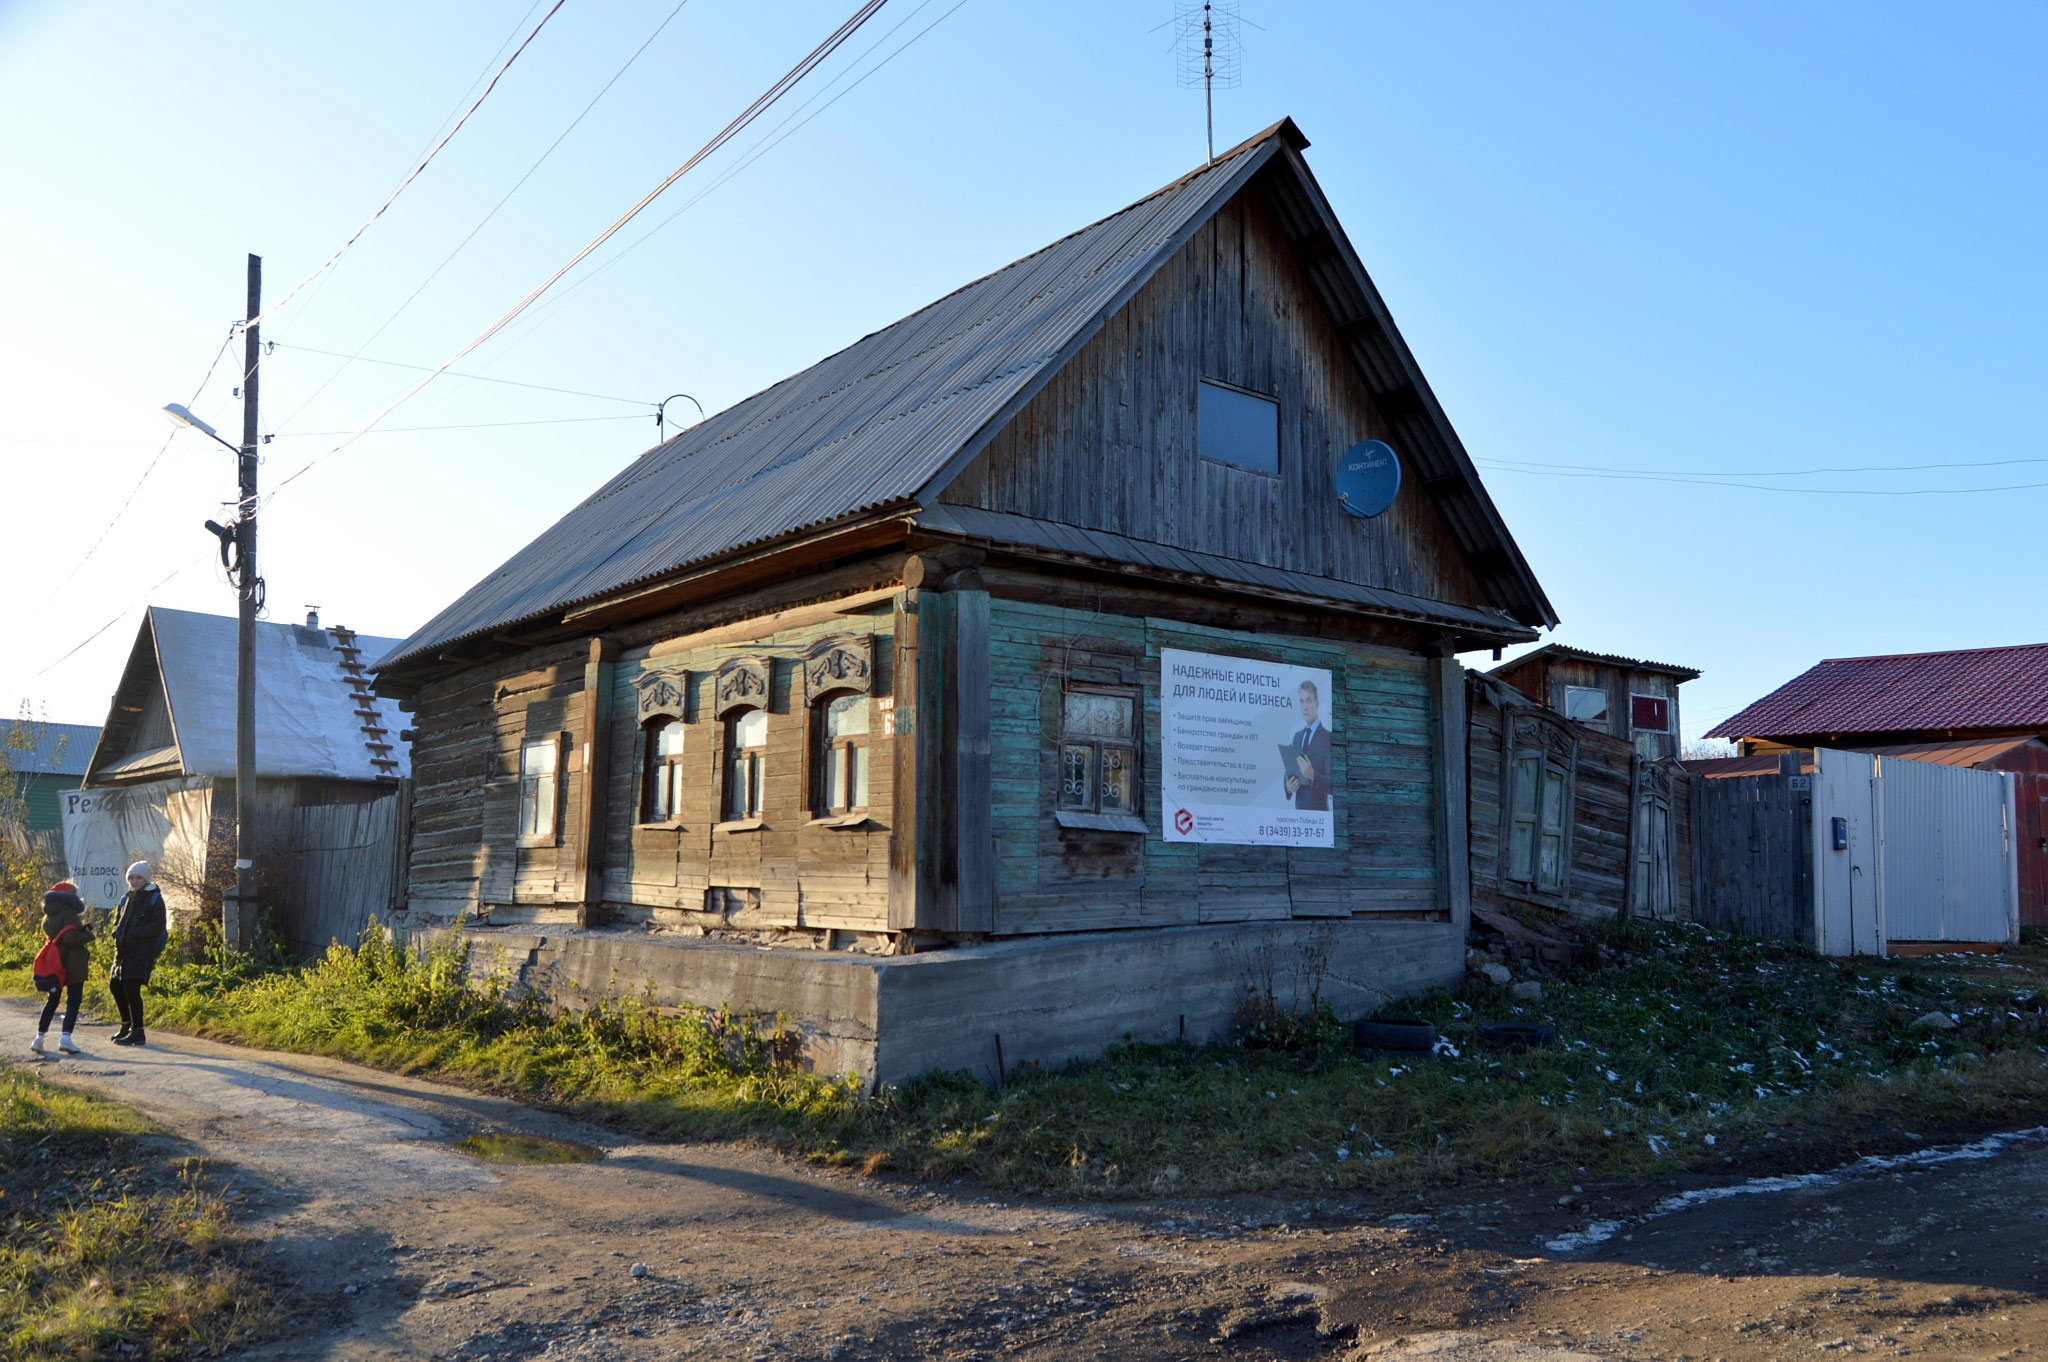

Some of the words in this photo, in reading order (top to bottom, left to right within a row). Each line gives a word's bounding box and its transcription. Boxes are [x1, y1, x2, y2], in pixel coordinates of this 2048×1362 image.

[1348, 459, 1387, 471] КОНТИНЕНТ
[1172, 664, 1234, 682] НАДЕЖНЫЕ
[1236, 672, 1280, 688] ЮРИСТЫ
[1173, 684, 1195, 698] ДЛЯ
[1197, 687, 1236, 702] ЛЮДЕЙ
[1239, 692, 1246, 703] И
[1248, 692, 1292, 708] БИЗНЕСА
[1177, 712, 1200, 721] Защита
[1177, 726, 1216, 737] Банкротство
[1177, 741, 1202, 751] Возврат
[1204, 745, 1235, 753] страховок
[1177, 756, 1237, 768] Представительство
[1178, 771, 1214, 781] Бесплатные
[1216, 776, 1256, 785] консультации
[1186, 785, 1228, 793] гражданским
[1276, 817, 1299, 825] проспект
[1259, 826, 1264, 836] 8
[1266, 825, 1290, 838] (3439)
[1292, 827, 1325, 838] 33-97-67
